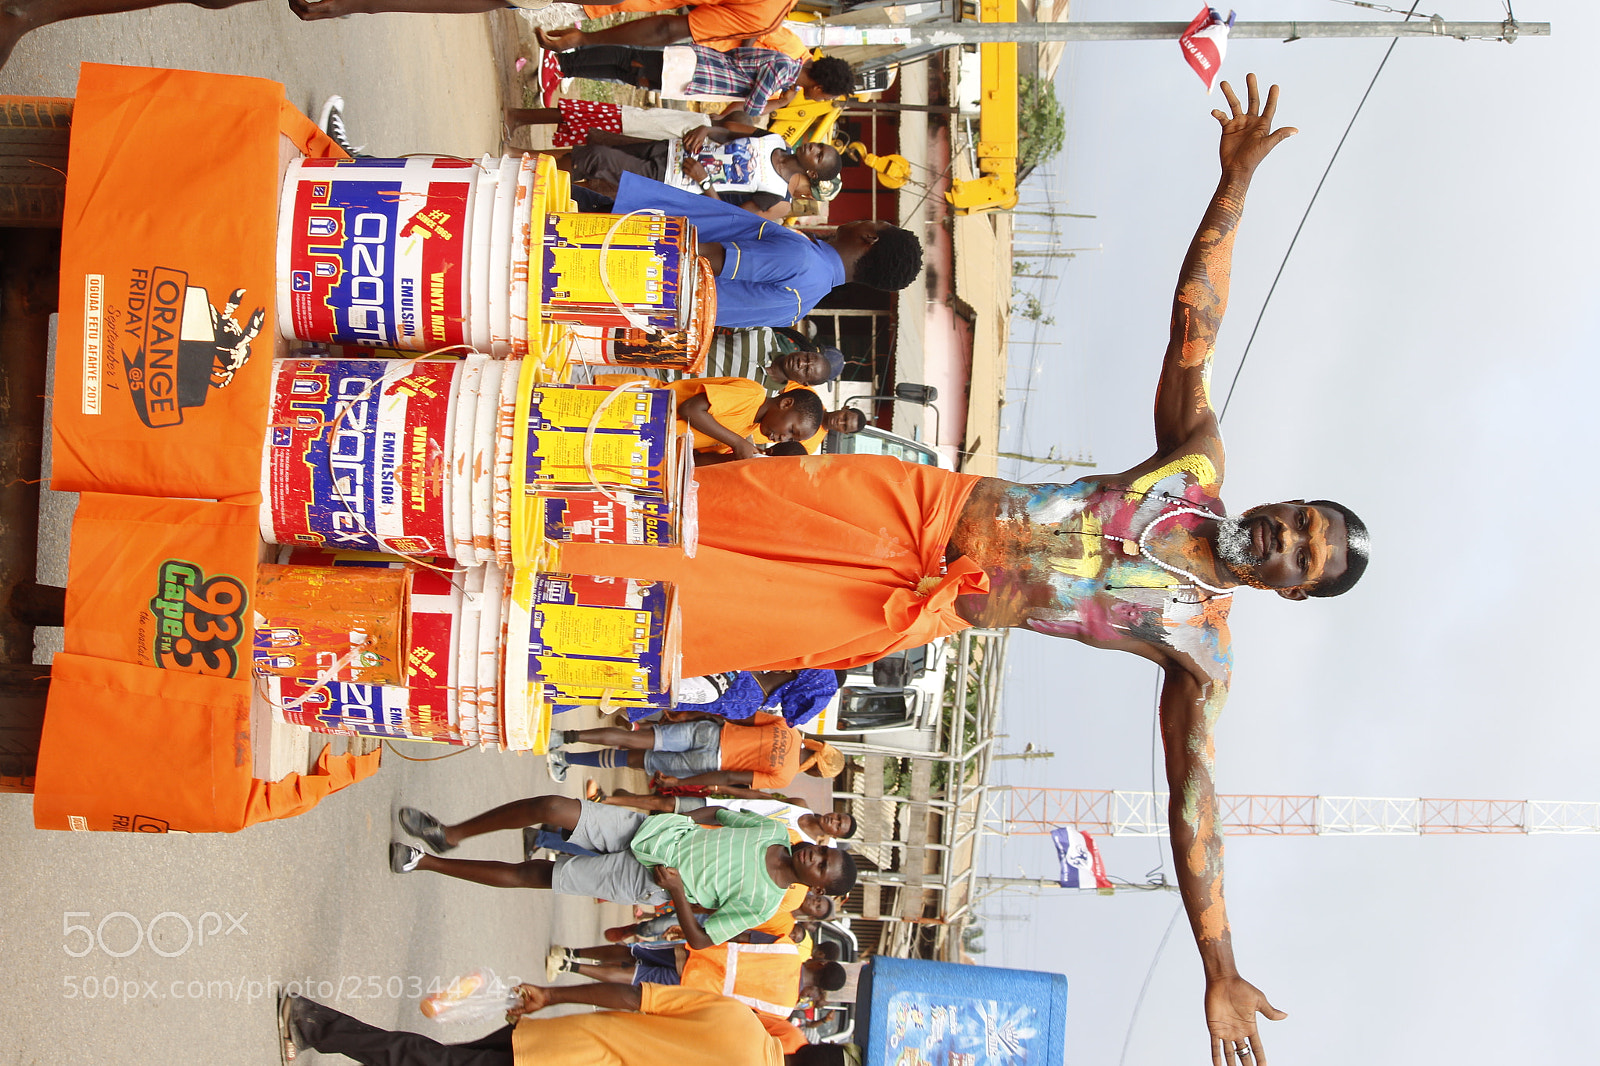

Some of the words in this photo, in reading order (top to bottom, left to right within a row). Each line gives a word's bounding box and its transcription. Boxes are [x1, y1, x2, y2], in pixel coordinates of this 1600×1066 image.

[428, 210, 451, 224] #1
[88, 278, 100, 312] OGUAA
[124, 268, 148, 339] FRIDAY
[401, 278, 416, 337] EMULSION
[430, 272, 444, 312] VINYL
[88, 316, 99, 340] FETU
[104, 305, 122, 376] September
[431, 315, 446, 342] MATT
[87, 344, 98, 382] AFAHYE
[149, 280, 180, 414] ORANGE
[128, 368, 144, 391] @5
[86, 386, 97, 410] 2017
[381, 432, 396, 504] EMULSION
[139, 612, 150, 624] the
[156, 564, 196, 638] Cape
[138, 628, 150, 660] coastal
[161, 636, 172, 651] FM
